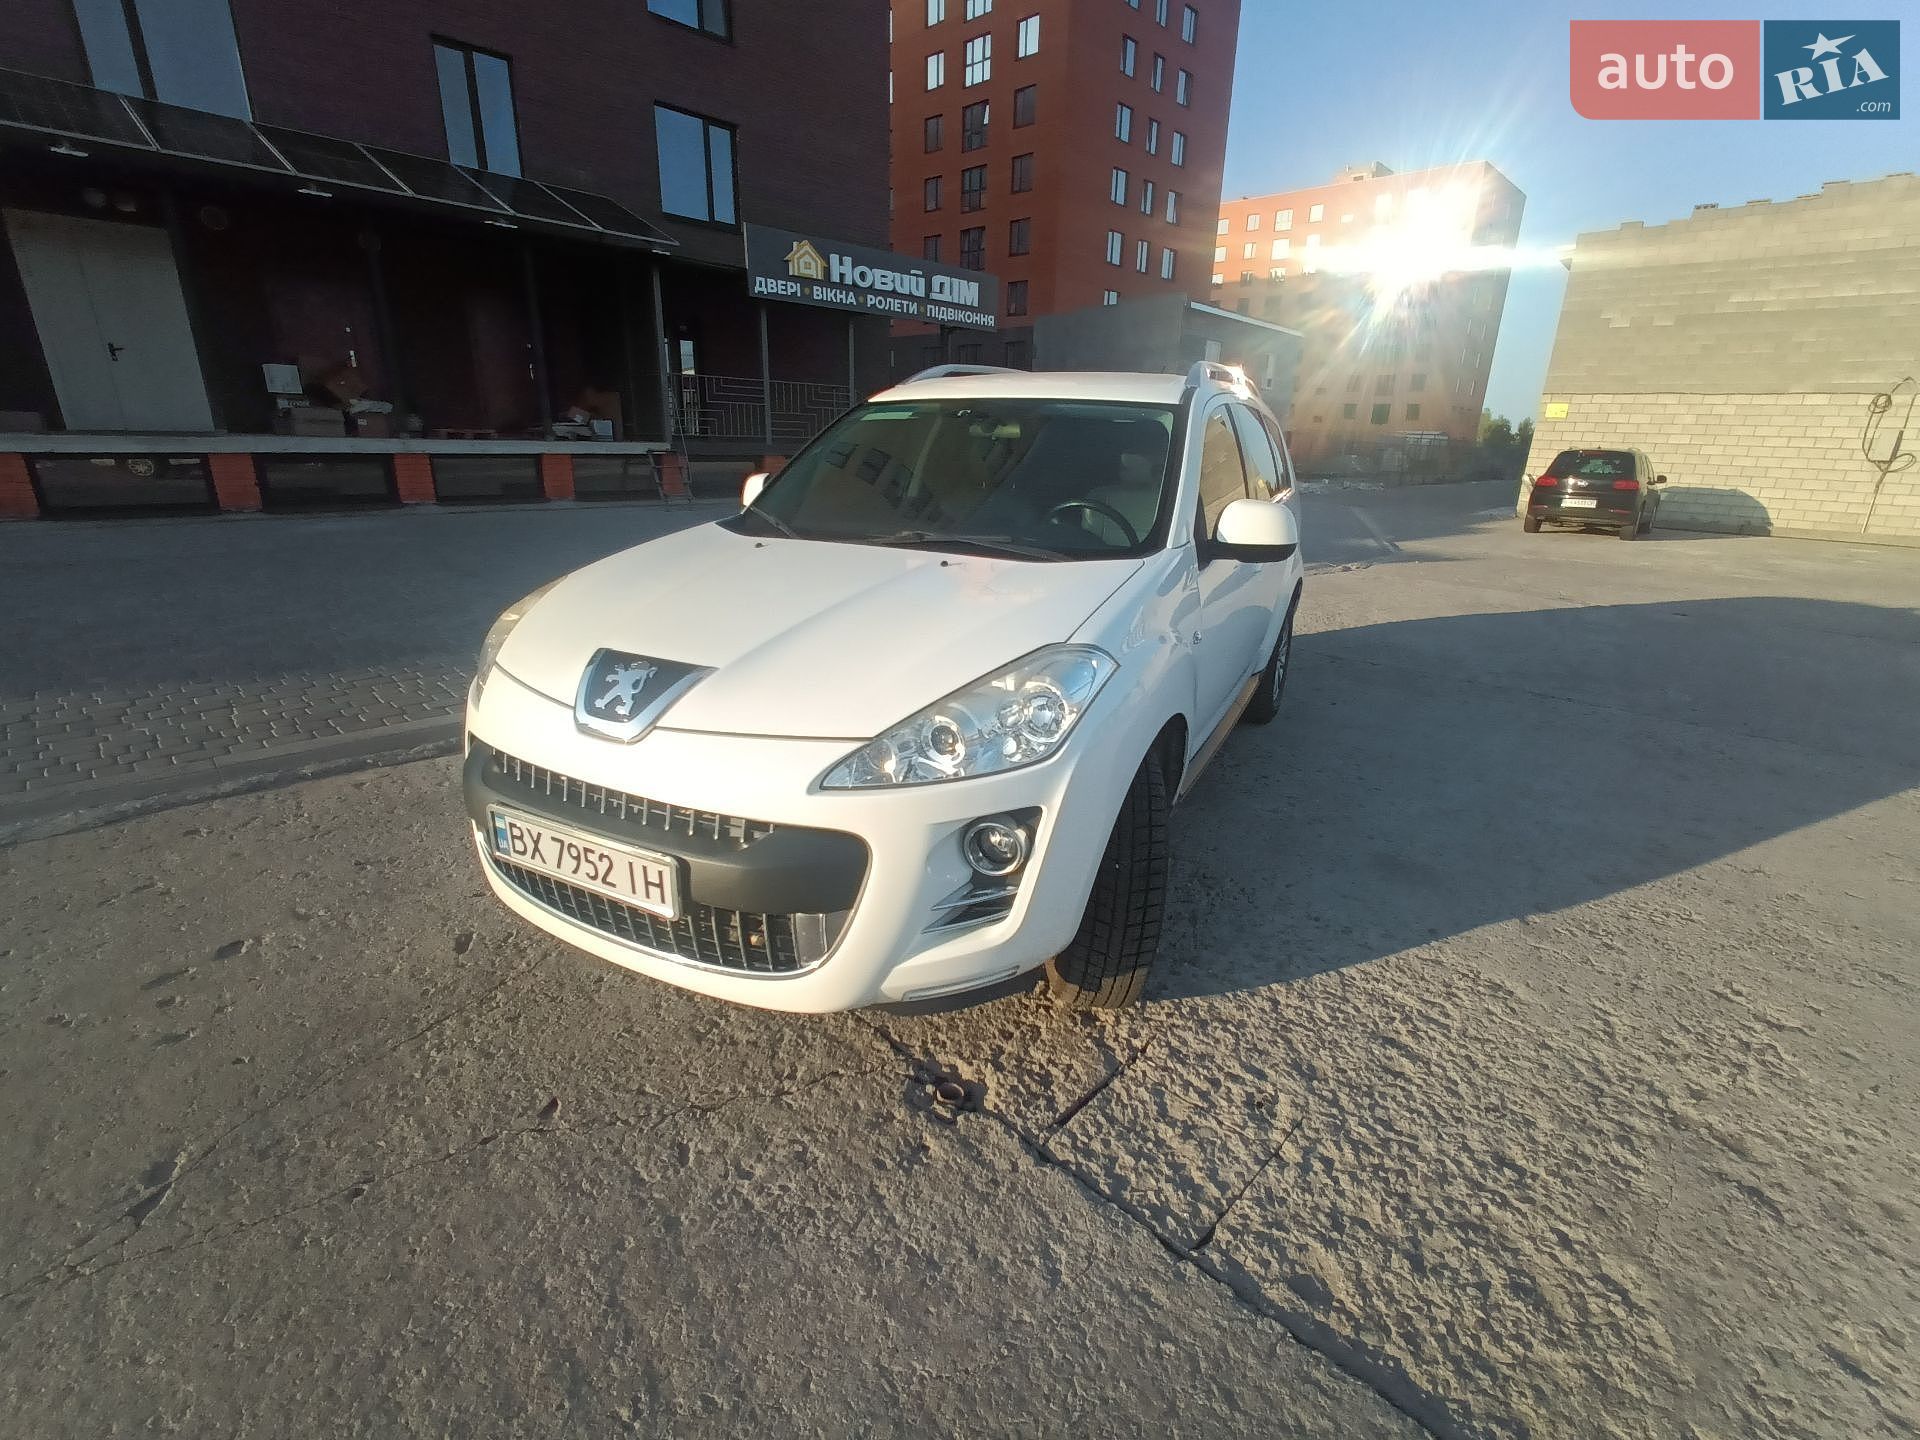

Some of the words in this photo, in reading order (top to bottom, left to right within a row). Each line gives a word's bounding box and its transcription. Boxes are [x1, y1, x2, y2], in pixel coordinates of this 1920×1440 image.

[754, 276, 801, 297] ДВЕРІ
[813, 285, 857, 306] ВІКНА
[866, 294, 918, 315] РОЛЕТИ
[926, 304, 996, 328] ПІДВІКОННЯ
[550, 836, 617, 889] 7952
